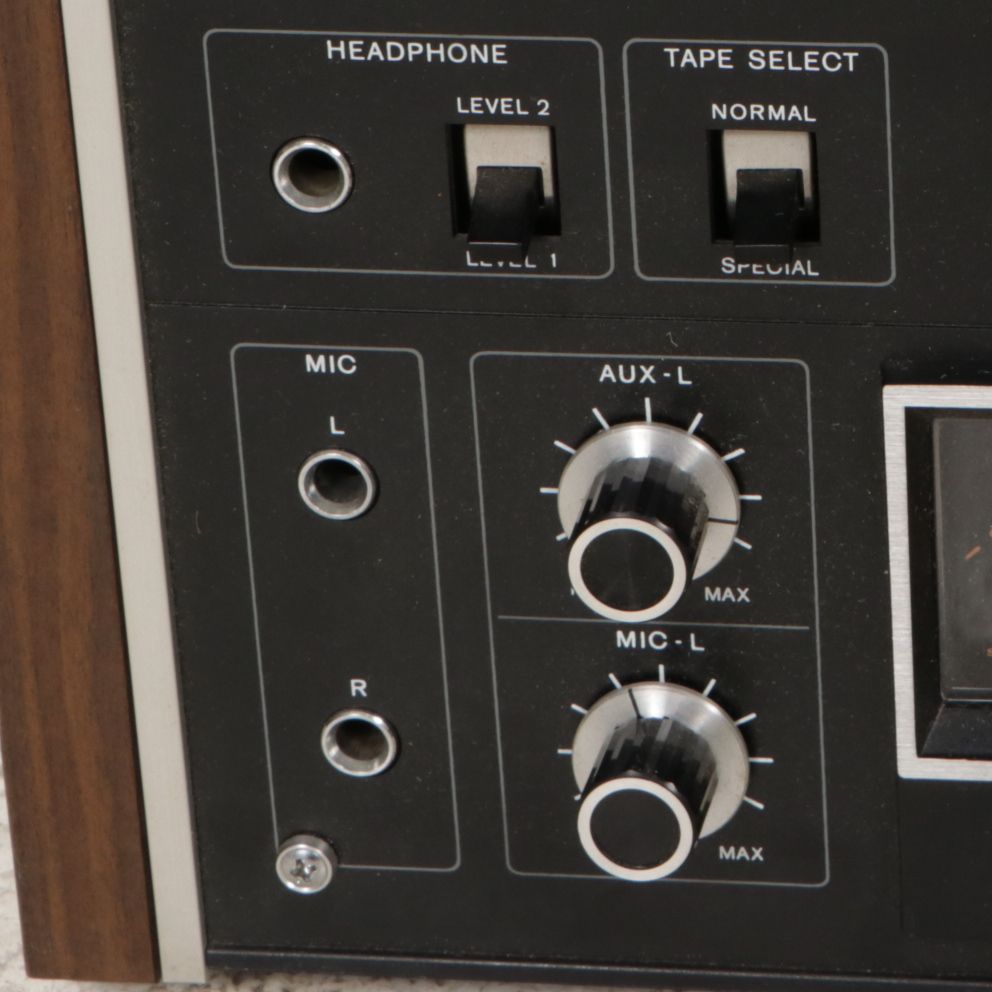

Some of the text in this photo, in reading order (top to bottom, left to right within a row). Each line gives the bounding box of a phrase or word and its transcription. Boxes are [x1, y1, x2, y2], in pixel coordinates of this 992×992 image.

[327, 39, 508, 64] HEADPHONE
[664, 48, 858, 71] TAPE SELECT
[457, 97, 549, 115] LEVEL 2
[712, 104, 816, 121] NORMAL
[306, 354, 356, 374] MIC
[330, 416, 345, 434] L
[705, 587, 750, 602] MAX
[351, 679, 366, 696] R
[719, 846, 763, 861] MAX
